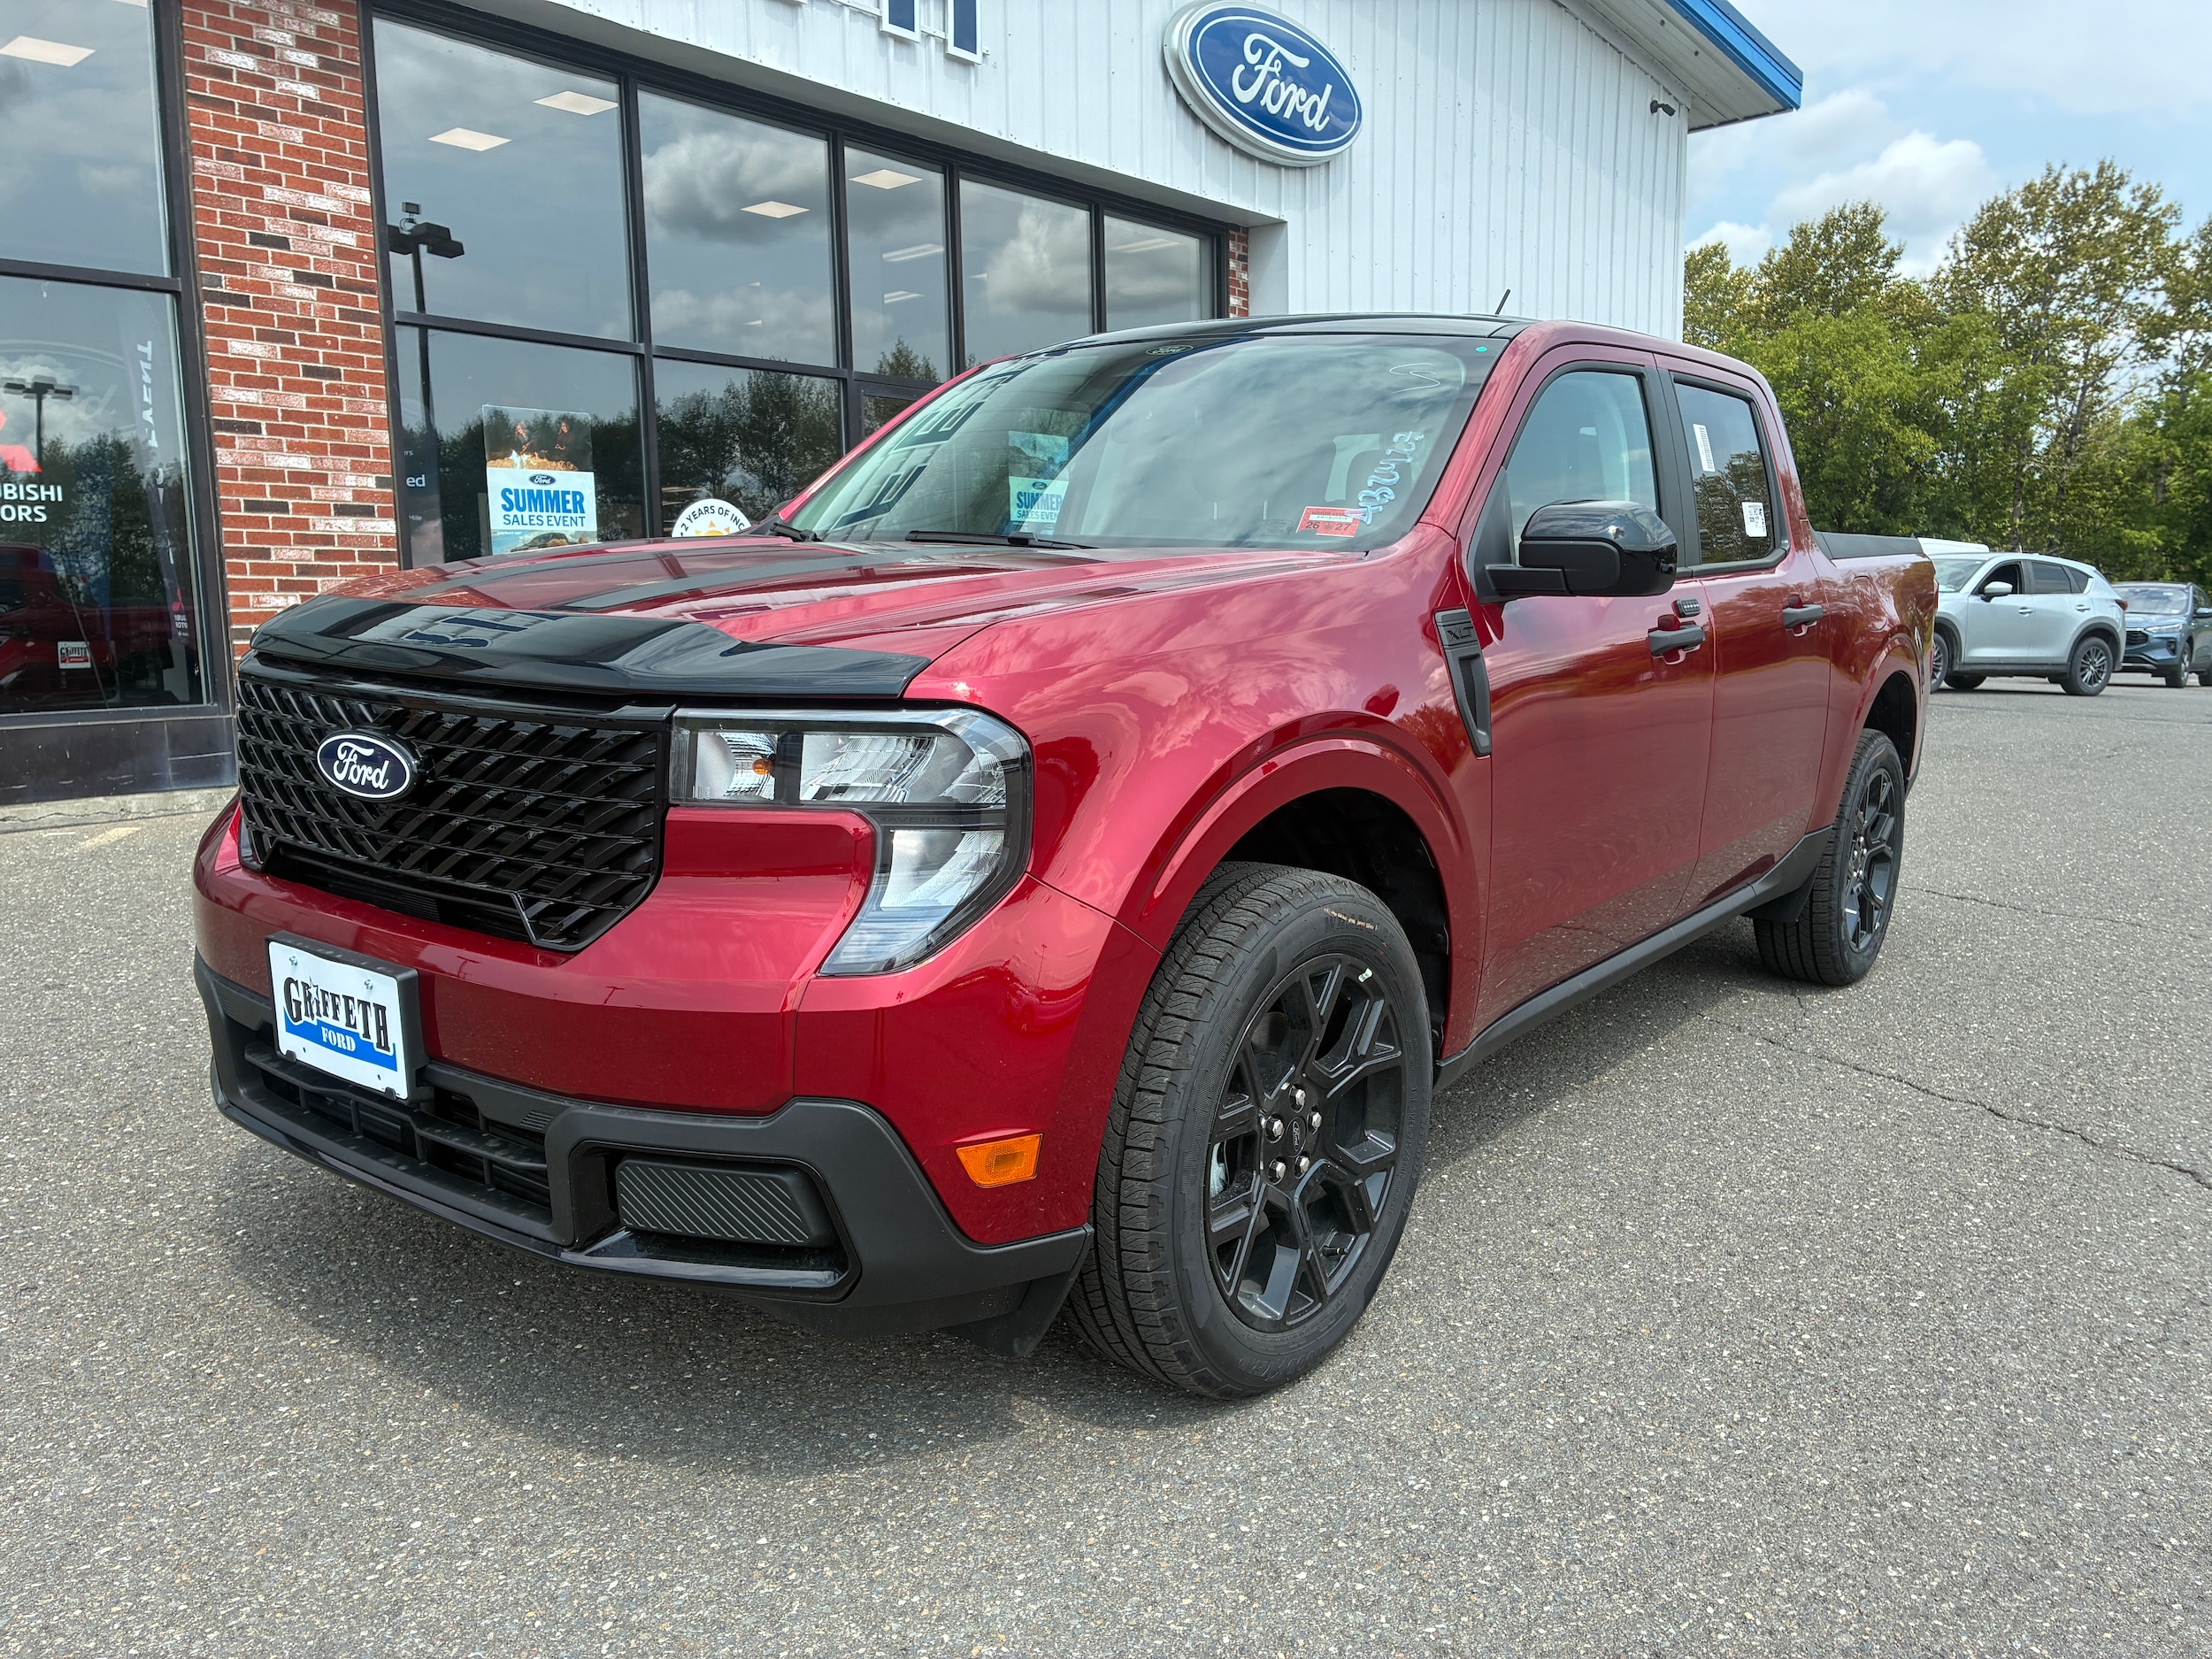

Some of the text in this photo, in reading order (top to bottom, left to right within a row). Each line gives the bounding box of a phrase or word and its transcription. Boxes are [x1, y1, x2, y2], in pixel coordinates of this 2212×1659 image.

[1232, 33, 1333, 132] Ford
[0, 482, 63, 502] BISHI
[501, 488, 586, 514] SUMMER
[0, 504, 48, 523] ORS
[503, 514, 586, 527] SALES EVENT
[686, 505, 716, 524] YEARS
[718, 507, 730, 518] OF
[1447, 626, 1474, 641] XLT
[333, 741, 389, 790] Ford
[321, 1025, 356, 1052] FORD
